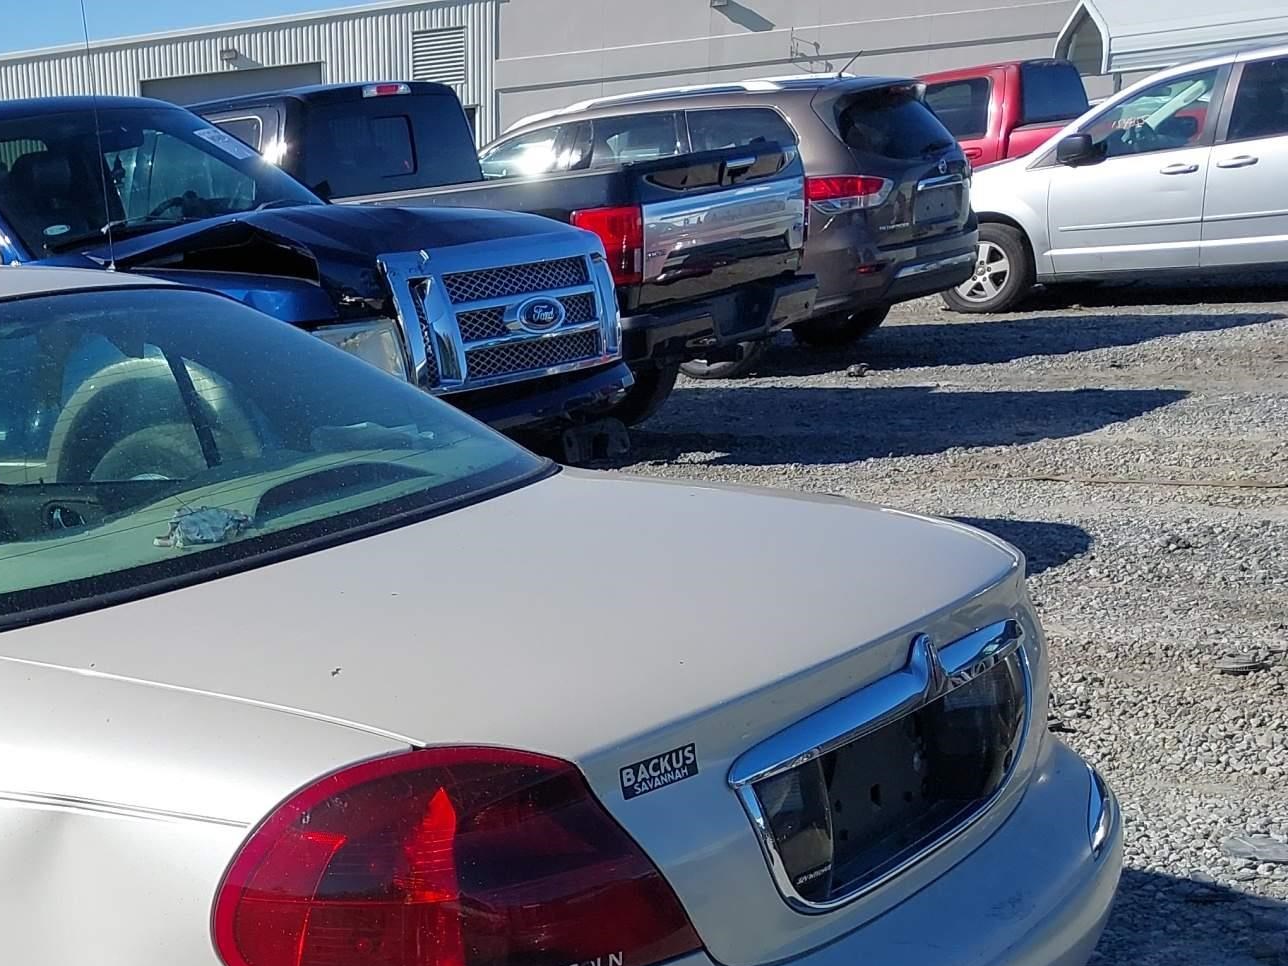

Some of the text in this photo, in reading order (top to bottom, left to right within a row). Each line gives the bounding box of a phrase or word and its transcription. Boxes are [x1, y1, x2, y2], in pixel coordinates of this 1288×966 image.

[533, 305, 555, 321] Ford
[622, 746, 695, 788] BACKUS
[634, 765, 689, 794] SAVANNAH
